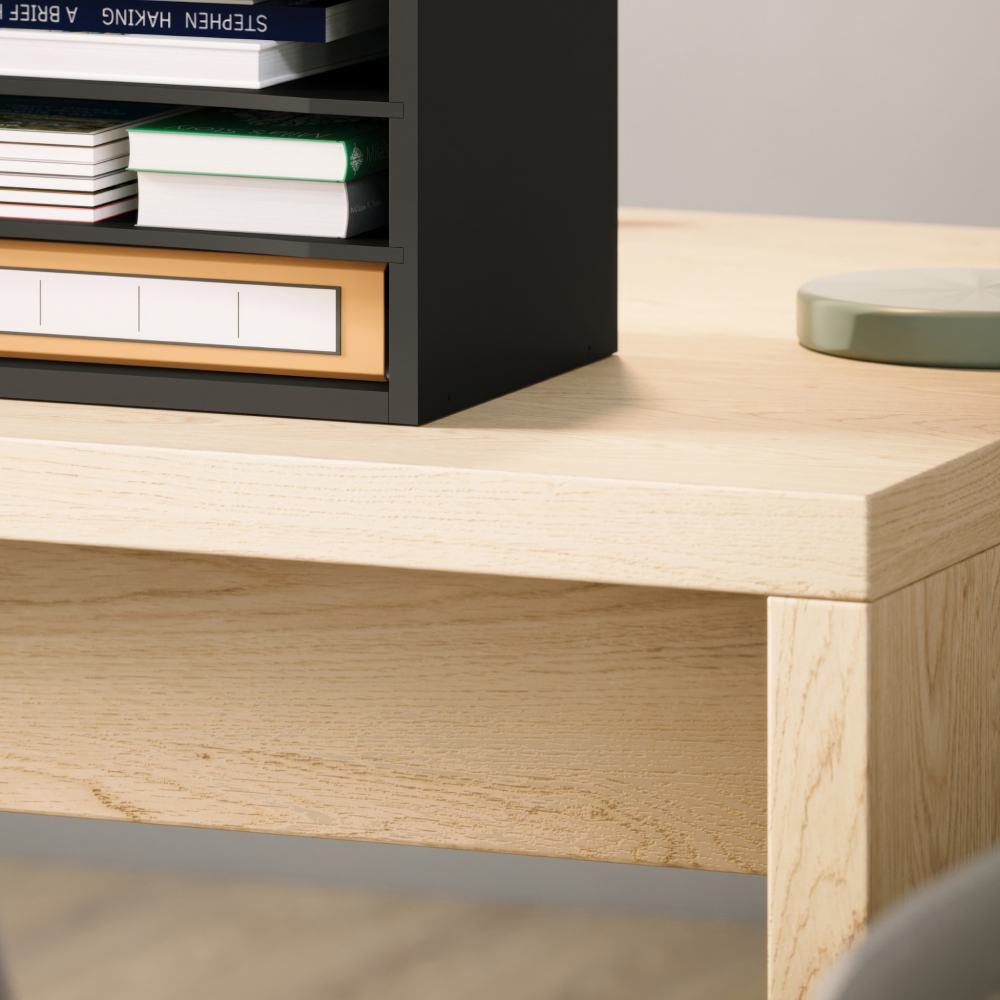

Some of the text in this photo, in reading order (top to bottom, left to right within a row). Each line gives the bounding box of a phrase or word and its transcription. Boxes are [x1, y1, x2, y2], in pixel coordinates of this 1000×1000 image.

[9, 3, 60, 23] BRIEF
[65, 6, 78, 24] A
[102, 7, 171, 29] HAKING
[185, 11, 268, 33] STEPHEN
